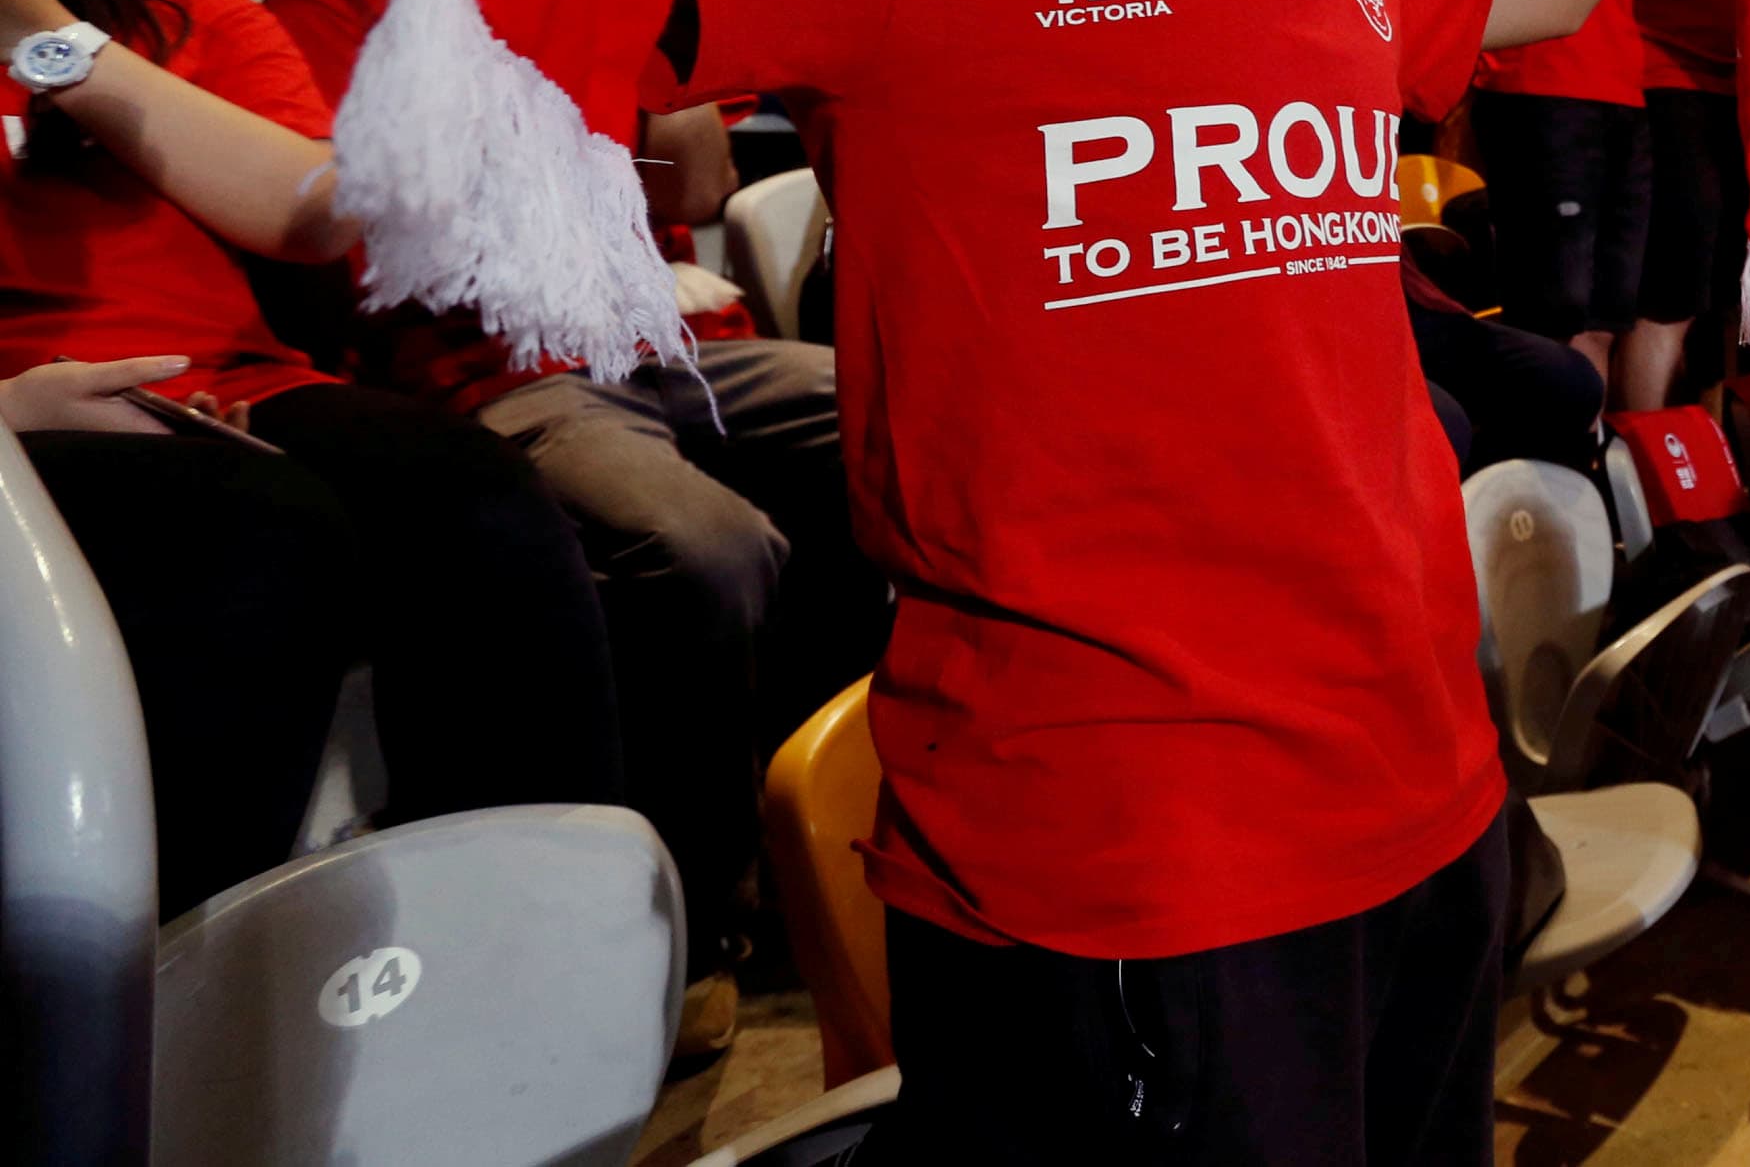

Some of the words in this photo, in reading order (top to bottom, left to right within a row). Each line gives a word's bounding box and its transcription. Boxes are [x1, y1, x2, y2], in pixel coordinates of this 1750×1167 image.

[1035, 0, 1172, 28] VICTORIA
[1044, 238, 1131, 284] TO
[1150, 222, 1229, 269] BE
[1286, 257, 1326, 275] SINCE
[337, 956, 408, 1013] 14
